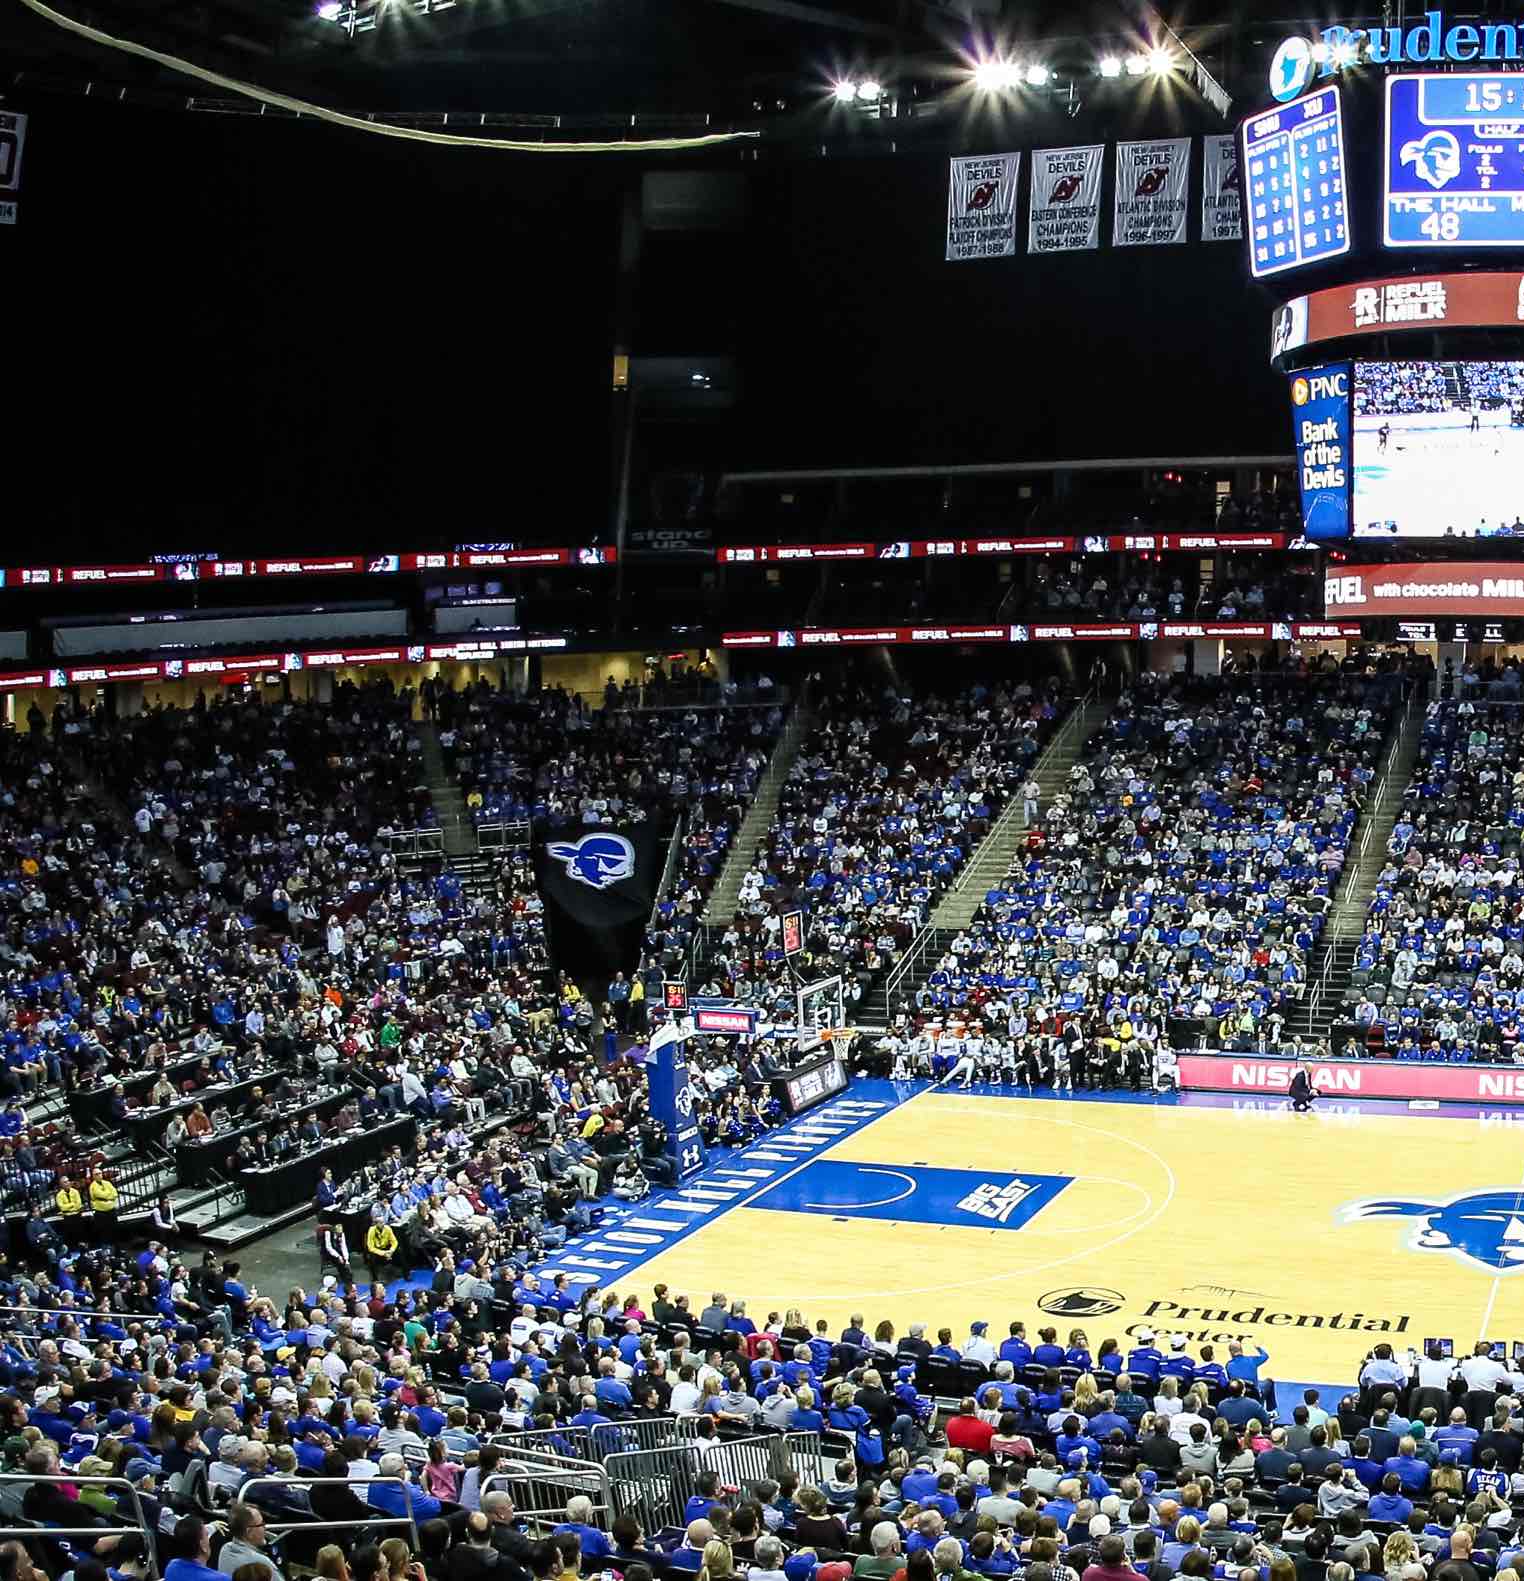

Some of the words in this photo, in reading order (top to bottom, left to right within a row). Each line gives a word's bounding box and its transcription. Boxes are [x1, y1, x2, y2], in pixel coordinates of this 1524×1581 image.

[1049, 161, 1085, 173] DEVILS
[1134, 154, 1172, 166] DEVILS
[967, 168, 1003, 180] DEVILS
[1481, 176, 1490, 189] 2
[1391, 198, 1432, 213] THE
[1441, 198, 1496, 213] HALL
[1037, 222, 1088, 236] CHAMPIONS
[1128, 215, 1173, 228] CHAMPIONS
[1421, 212, 1459, 240] 48
[1386, 302, 1446, 322] MILK
[1309, 373, 1348, 400] PNC
[1302, 417, 1338, 443] Bank
[1303, 464, 1345, 490] Devils
[1179, 538, 1217, 547] REFUEL
[1373, 583, 1400, 598] with
[1402, 583, 1479, 598] chocolate
[1035, 627, 1074, 638] REFUEL
[1164, 626, 1205, 636] REFUEL
[702, 1015, 749, 1026] NISSAN
[1232, 1064, 1361, 1090] NISAN
[537, 1217, 689, 1284] SETON
[653, 1168, 776, 1214] HALL
[741, 1100, 887, 1162] PIRATES
[956, 1183, 1003, 1212] BIG
[976, 1178, 1031, 1219] EAST
[1142, 1299, 1411, 1334] Prudential
